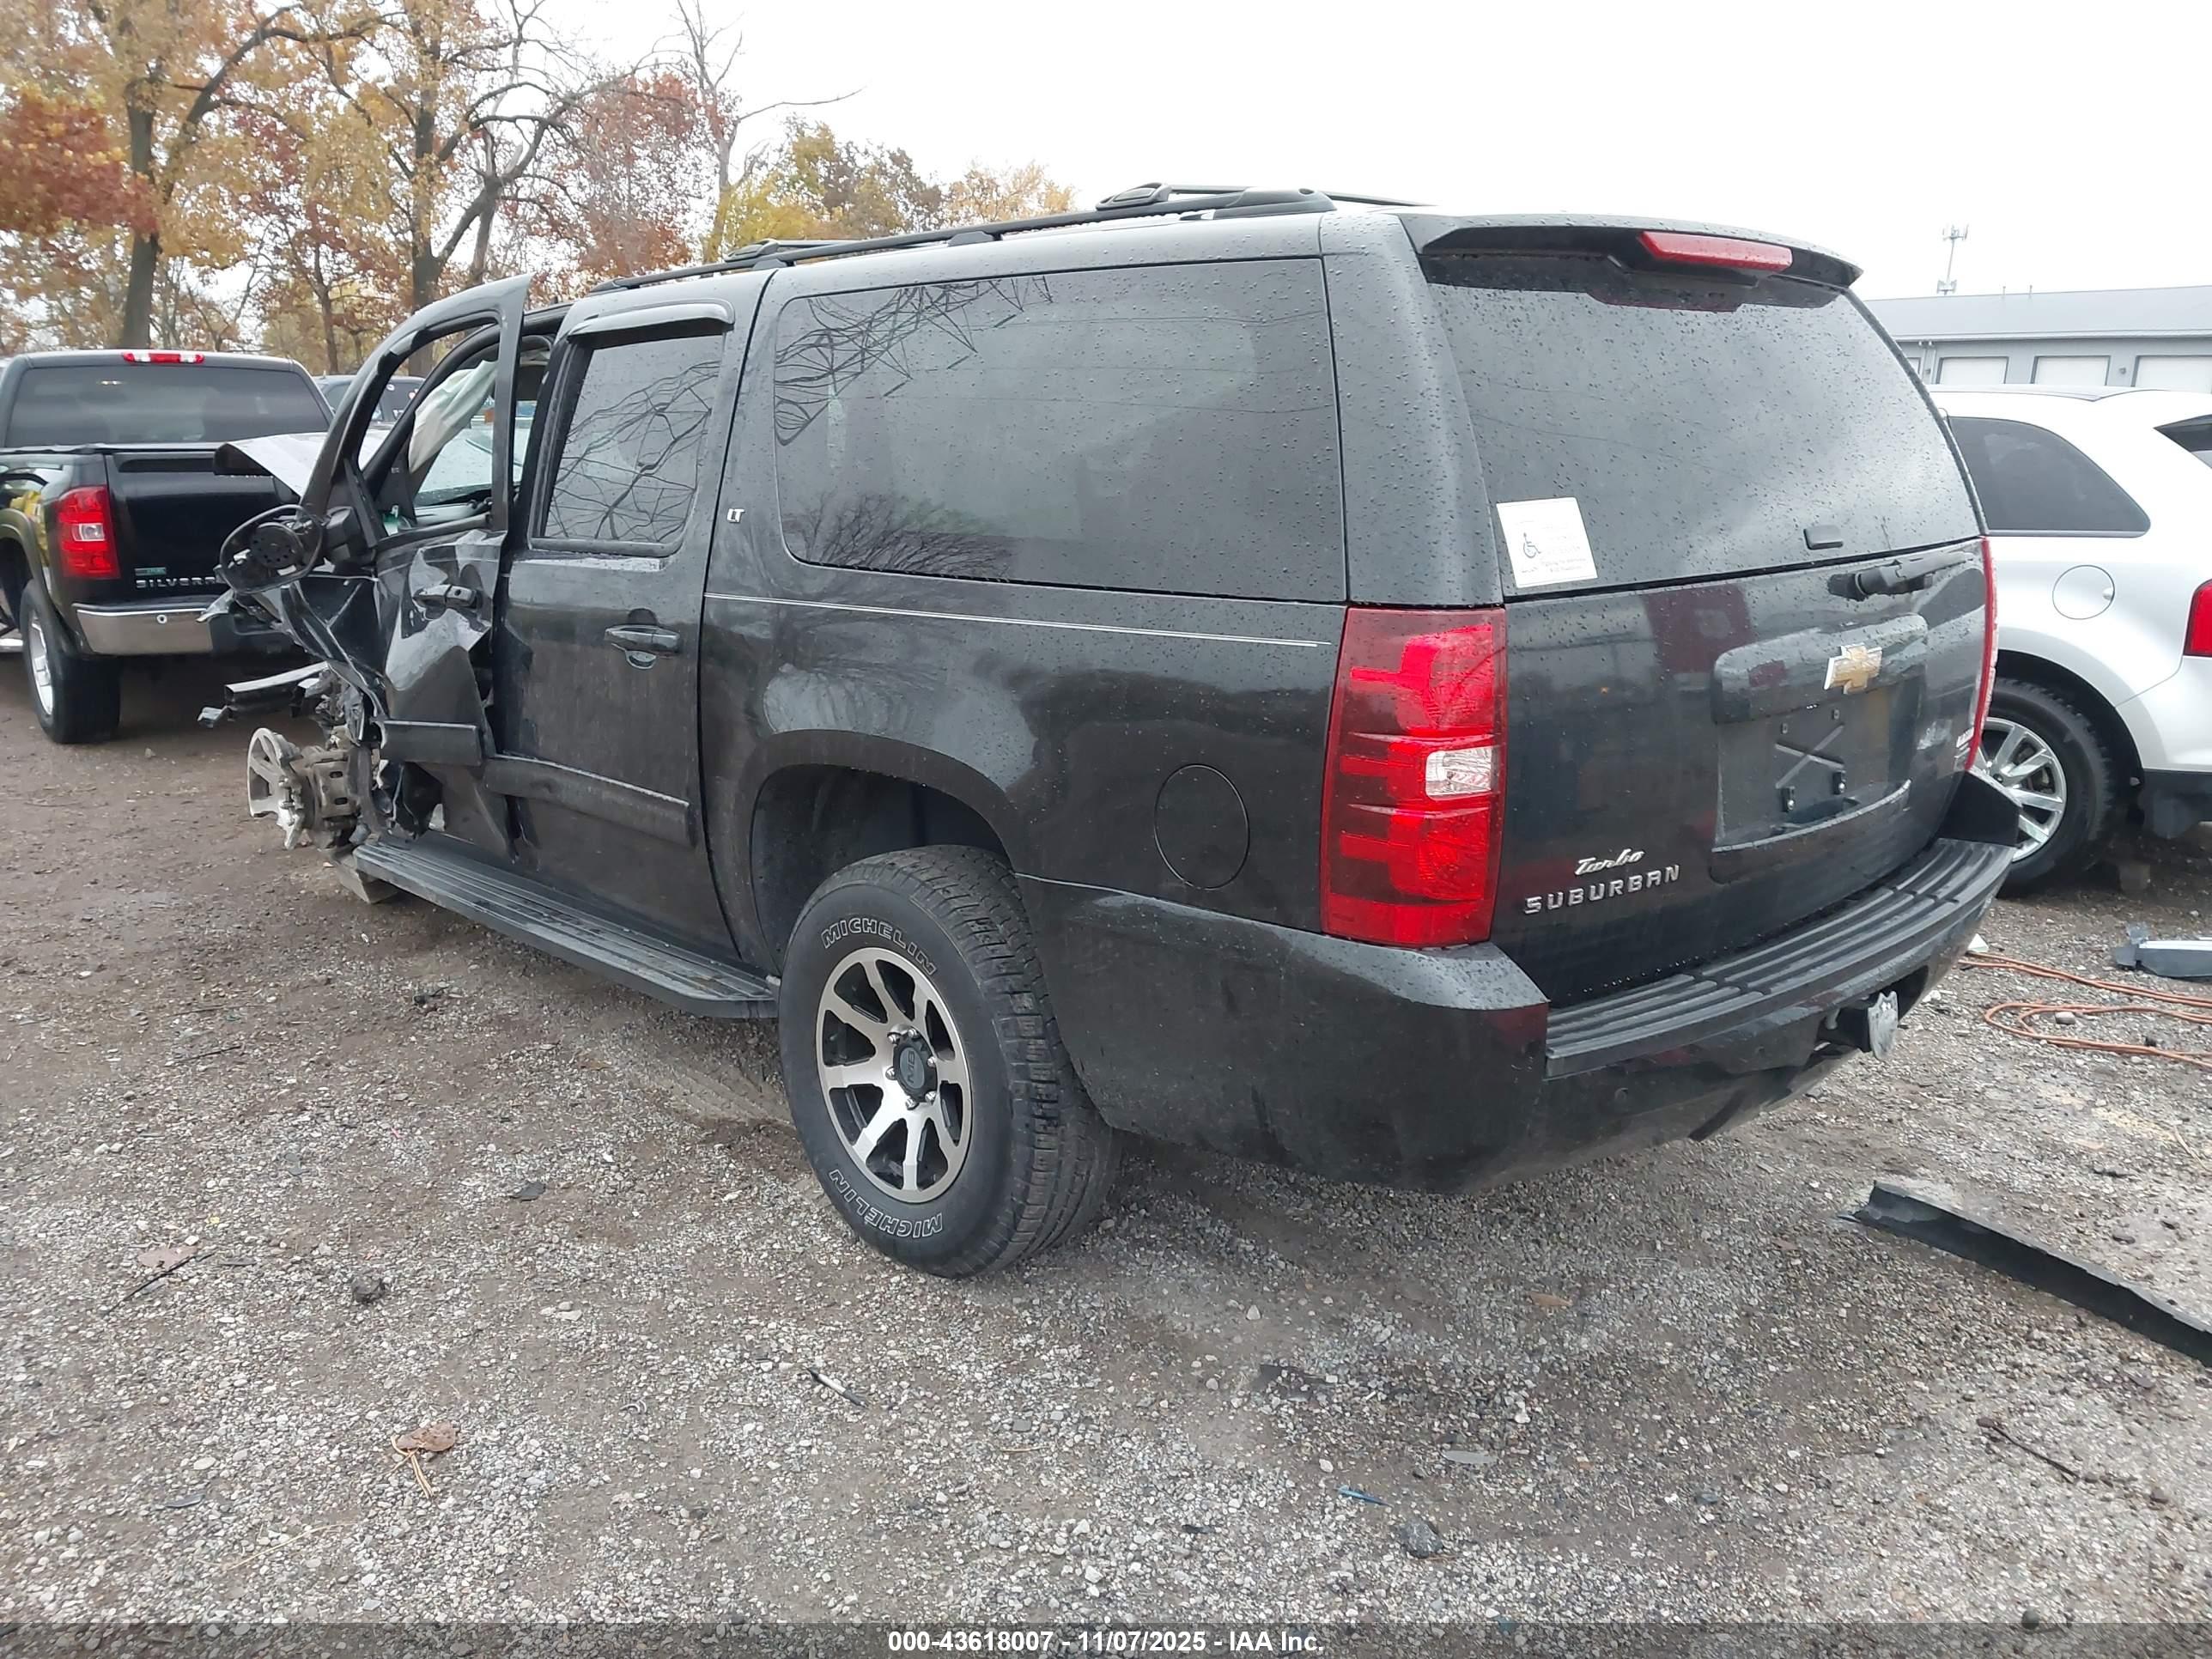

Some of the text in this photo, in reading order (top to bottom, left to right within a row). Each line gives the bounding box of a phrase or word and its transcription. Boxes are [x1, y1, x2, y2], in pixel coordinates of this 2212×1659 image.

[726, 507, 744, 523] LT
[1575, 848, 1645, 875] Turbo
[1523, 864, 1680, 914] SUBURBAN
[821, 917, 937, 975] MICHELIN
[829, 1169, 944, 1238] MICHELIN
